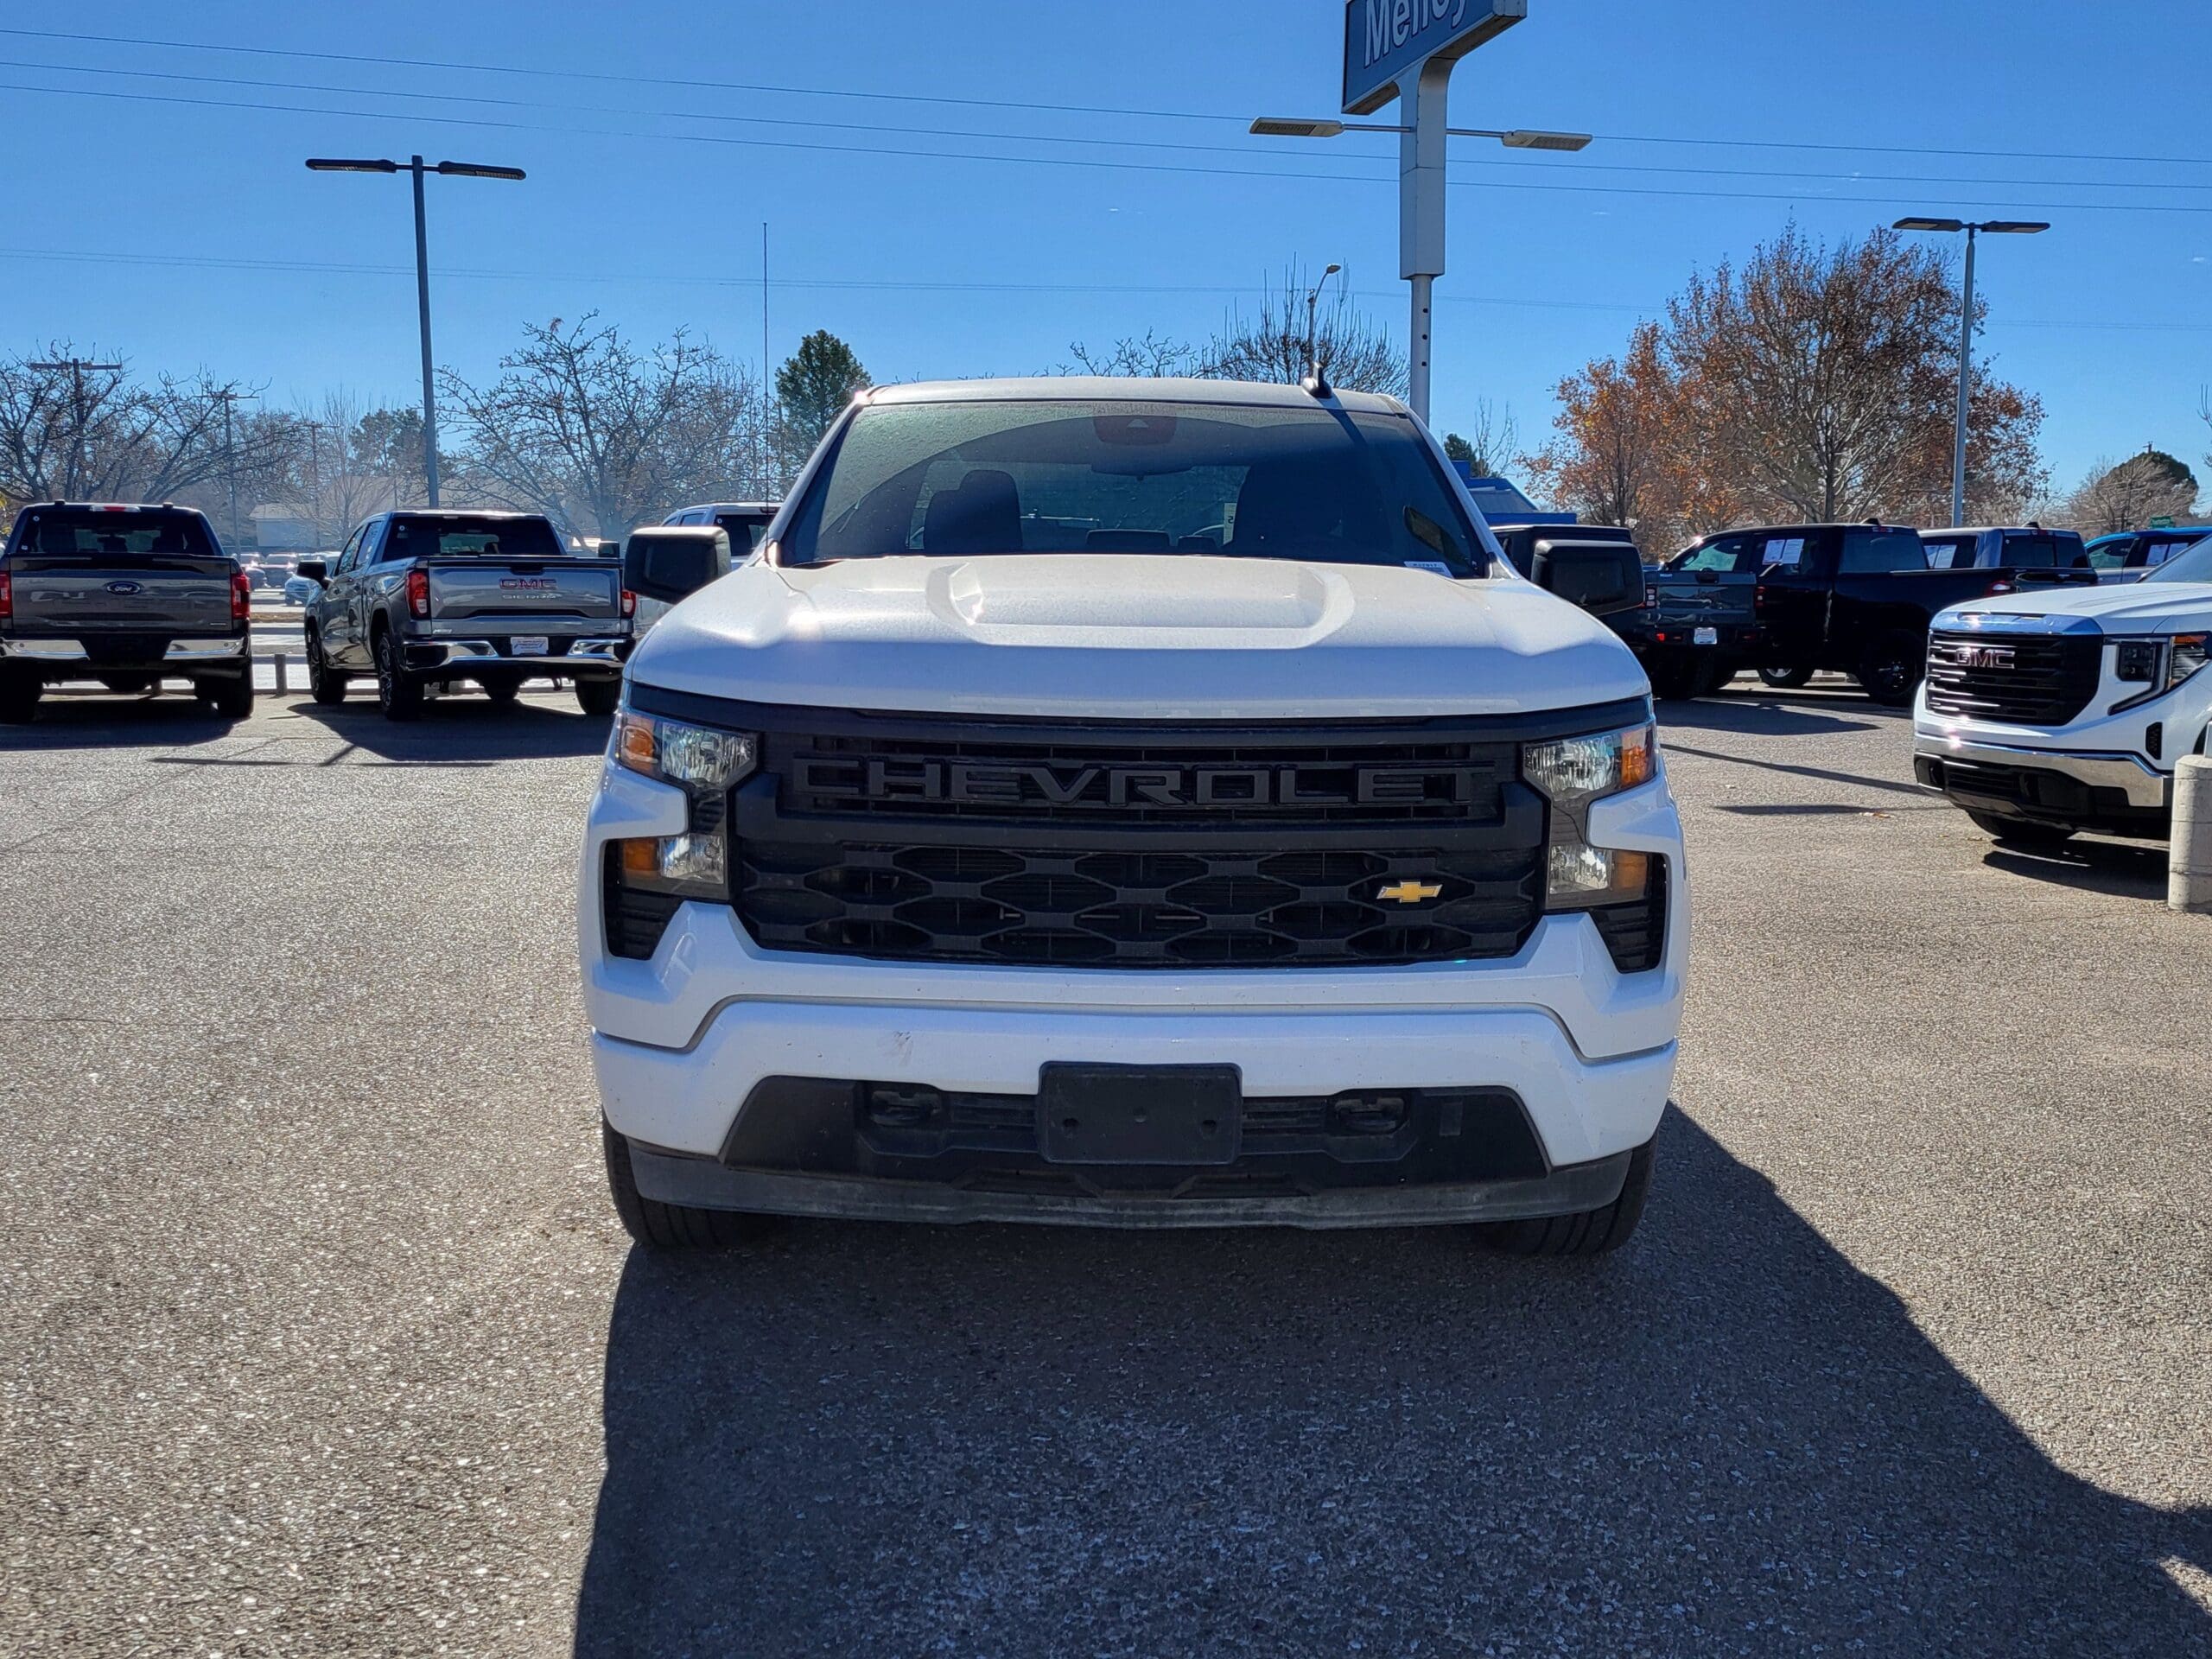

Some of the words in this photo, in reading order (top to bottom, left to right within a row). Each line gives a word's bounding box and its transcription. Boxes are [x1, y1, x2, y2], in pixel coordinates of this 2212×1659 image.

[500, 579, 557, 589] GMC
[1955, 647, 2016, 669] GMC
[792, 756, 1495, 805] CHEVROLET
